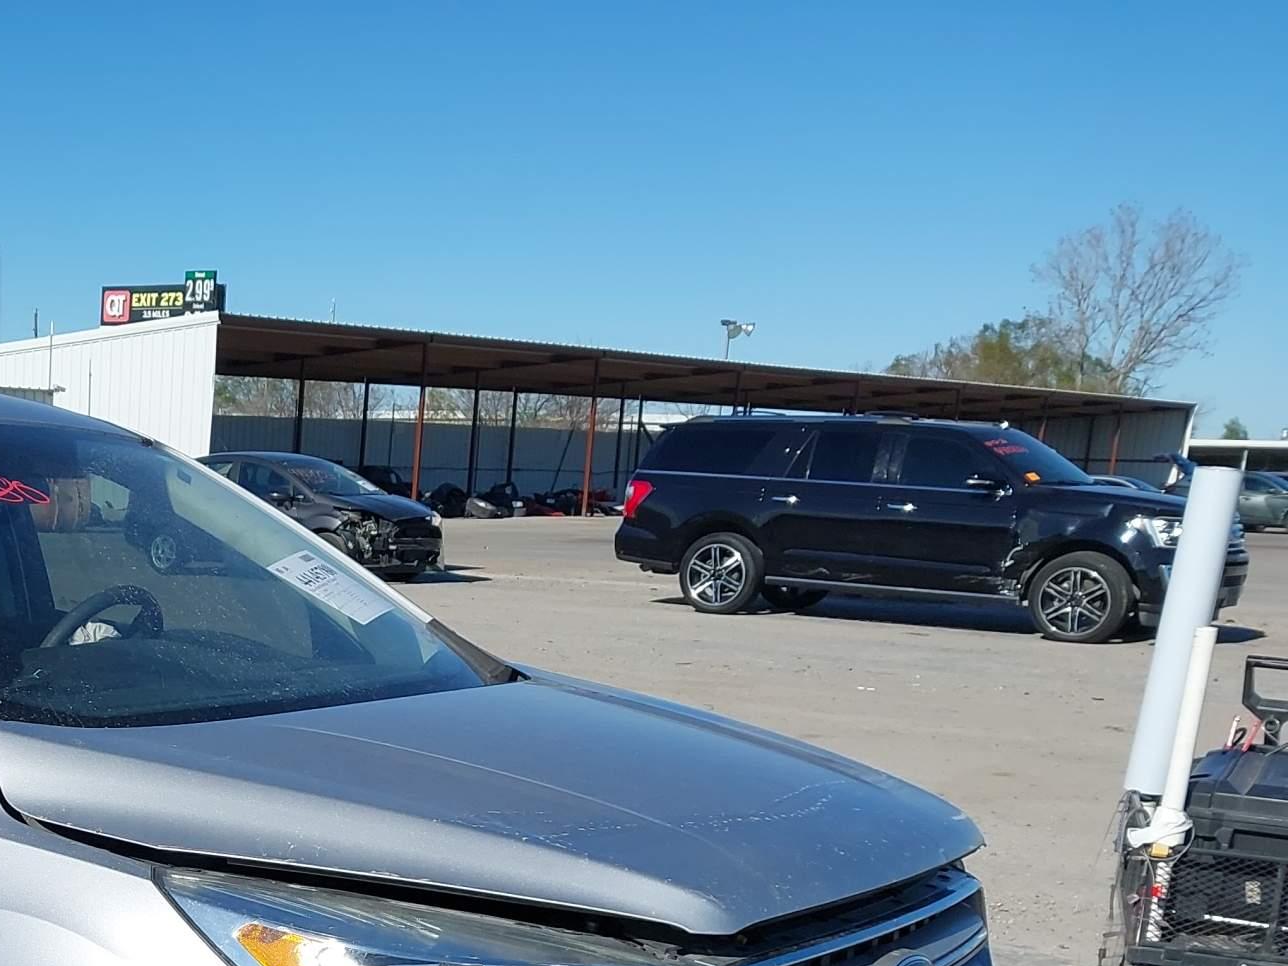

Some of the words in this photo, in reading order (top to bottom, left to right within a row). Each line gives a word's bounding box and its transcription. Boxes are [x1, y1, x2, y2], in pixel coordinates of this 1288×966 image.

[106, 295, 126, 318] QT
[132, 292, 158, 307] EXIT
[159, 292, 184, 306] 273
